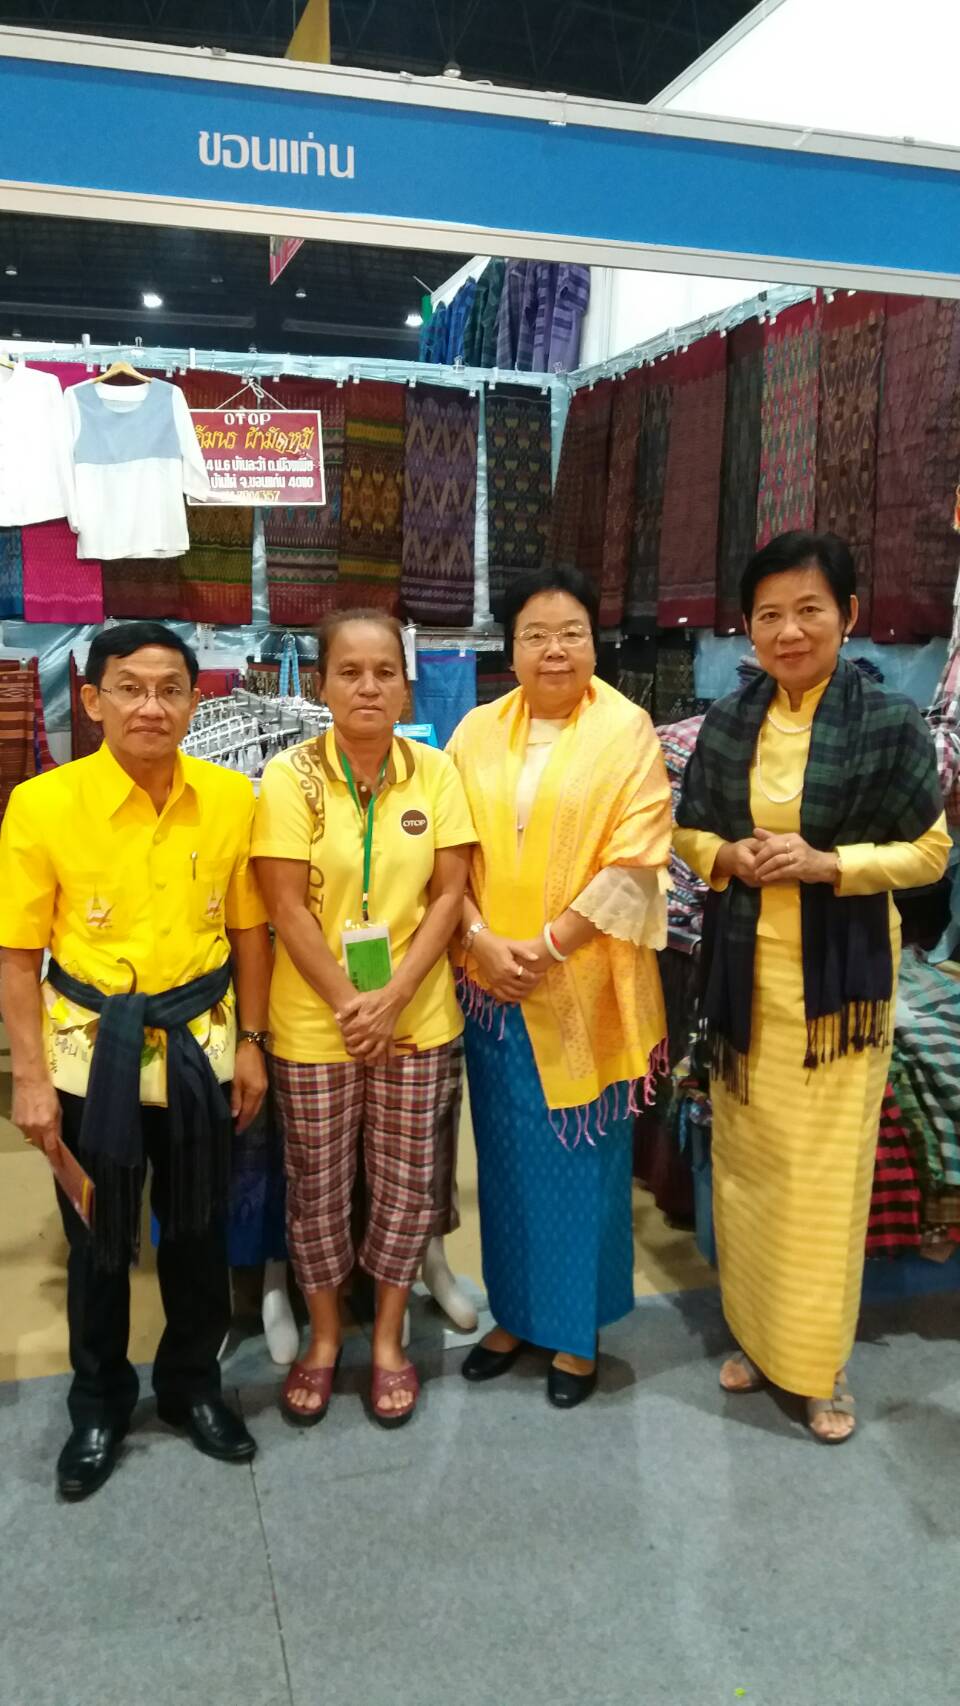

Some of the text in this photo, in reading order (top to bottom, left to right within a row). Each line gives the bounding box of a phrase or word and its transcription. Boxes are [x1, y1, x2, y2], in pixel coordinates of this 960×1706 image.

[198, 130, 355, 179] ขอนแก่น
[224, 413, 271, 425] OTOP
[402, 819, 426, 827] OTOP
